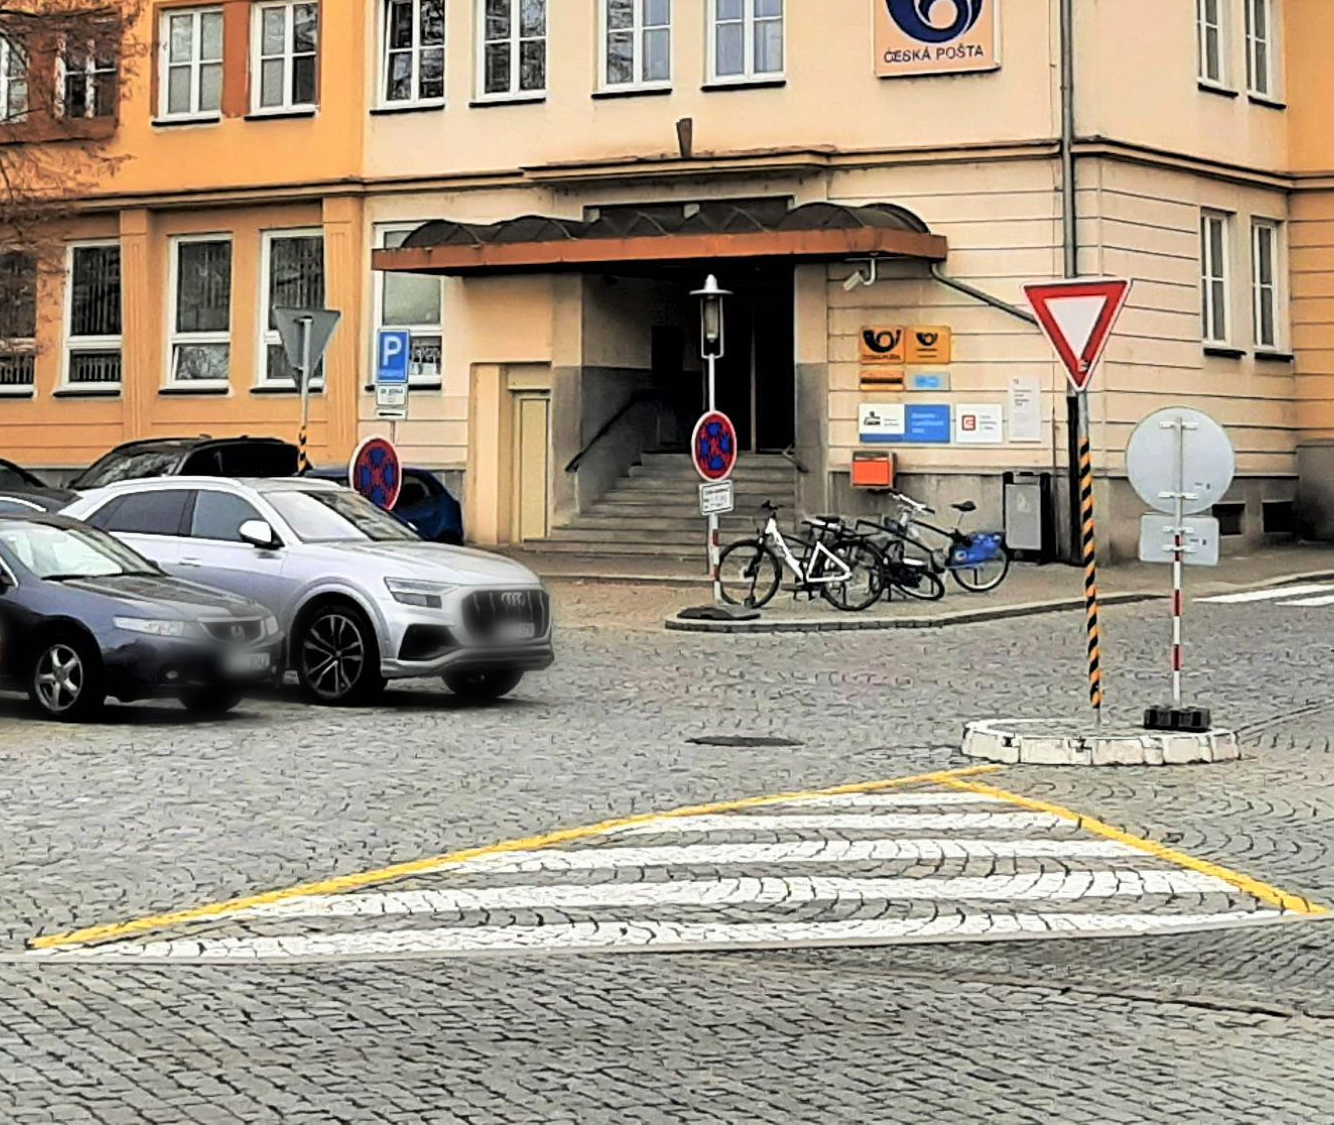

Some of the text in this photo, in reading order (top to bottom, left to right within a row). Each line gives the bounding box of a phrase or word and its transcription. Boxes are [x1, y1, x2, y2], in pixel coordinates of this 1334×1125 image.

[883, 44, 983, 63] ČESKÁ POŠTA
[382, 335, 402, 367] P
